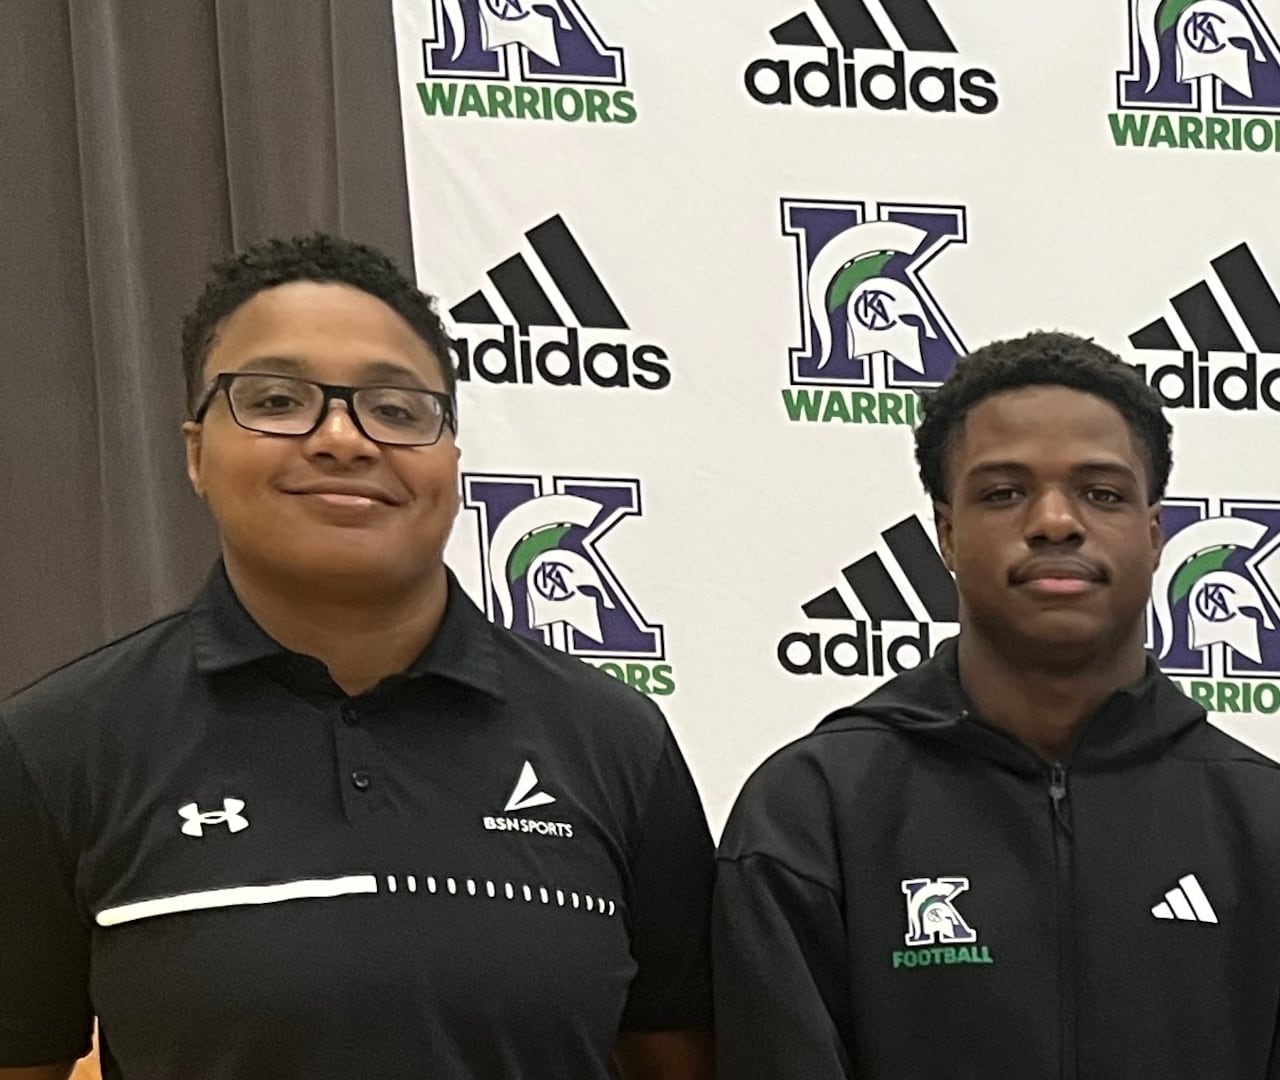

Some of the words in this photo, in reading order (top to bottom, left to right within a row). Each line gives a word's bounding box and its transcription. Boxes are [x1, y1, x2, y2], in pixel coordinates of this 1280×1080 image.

[743, 47, 999, 115] adidas
[416, 82, 638, 124] WARRIORS
[781, 389, 924, 425] WARRI
[777, 620, 937, 678] adid
[893, 946, 994, 969] FOOTBALL
